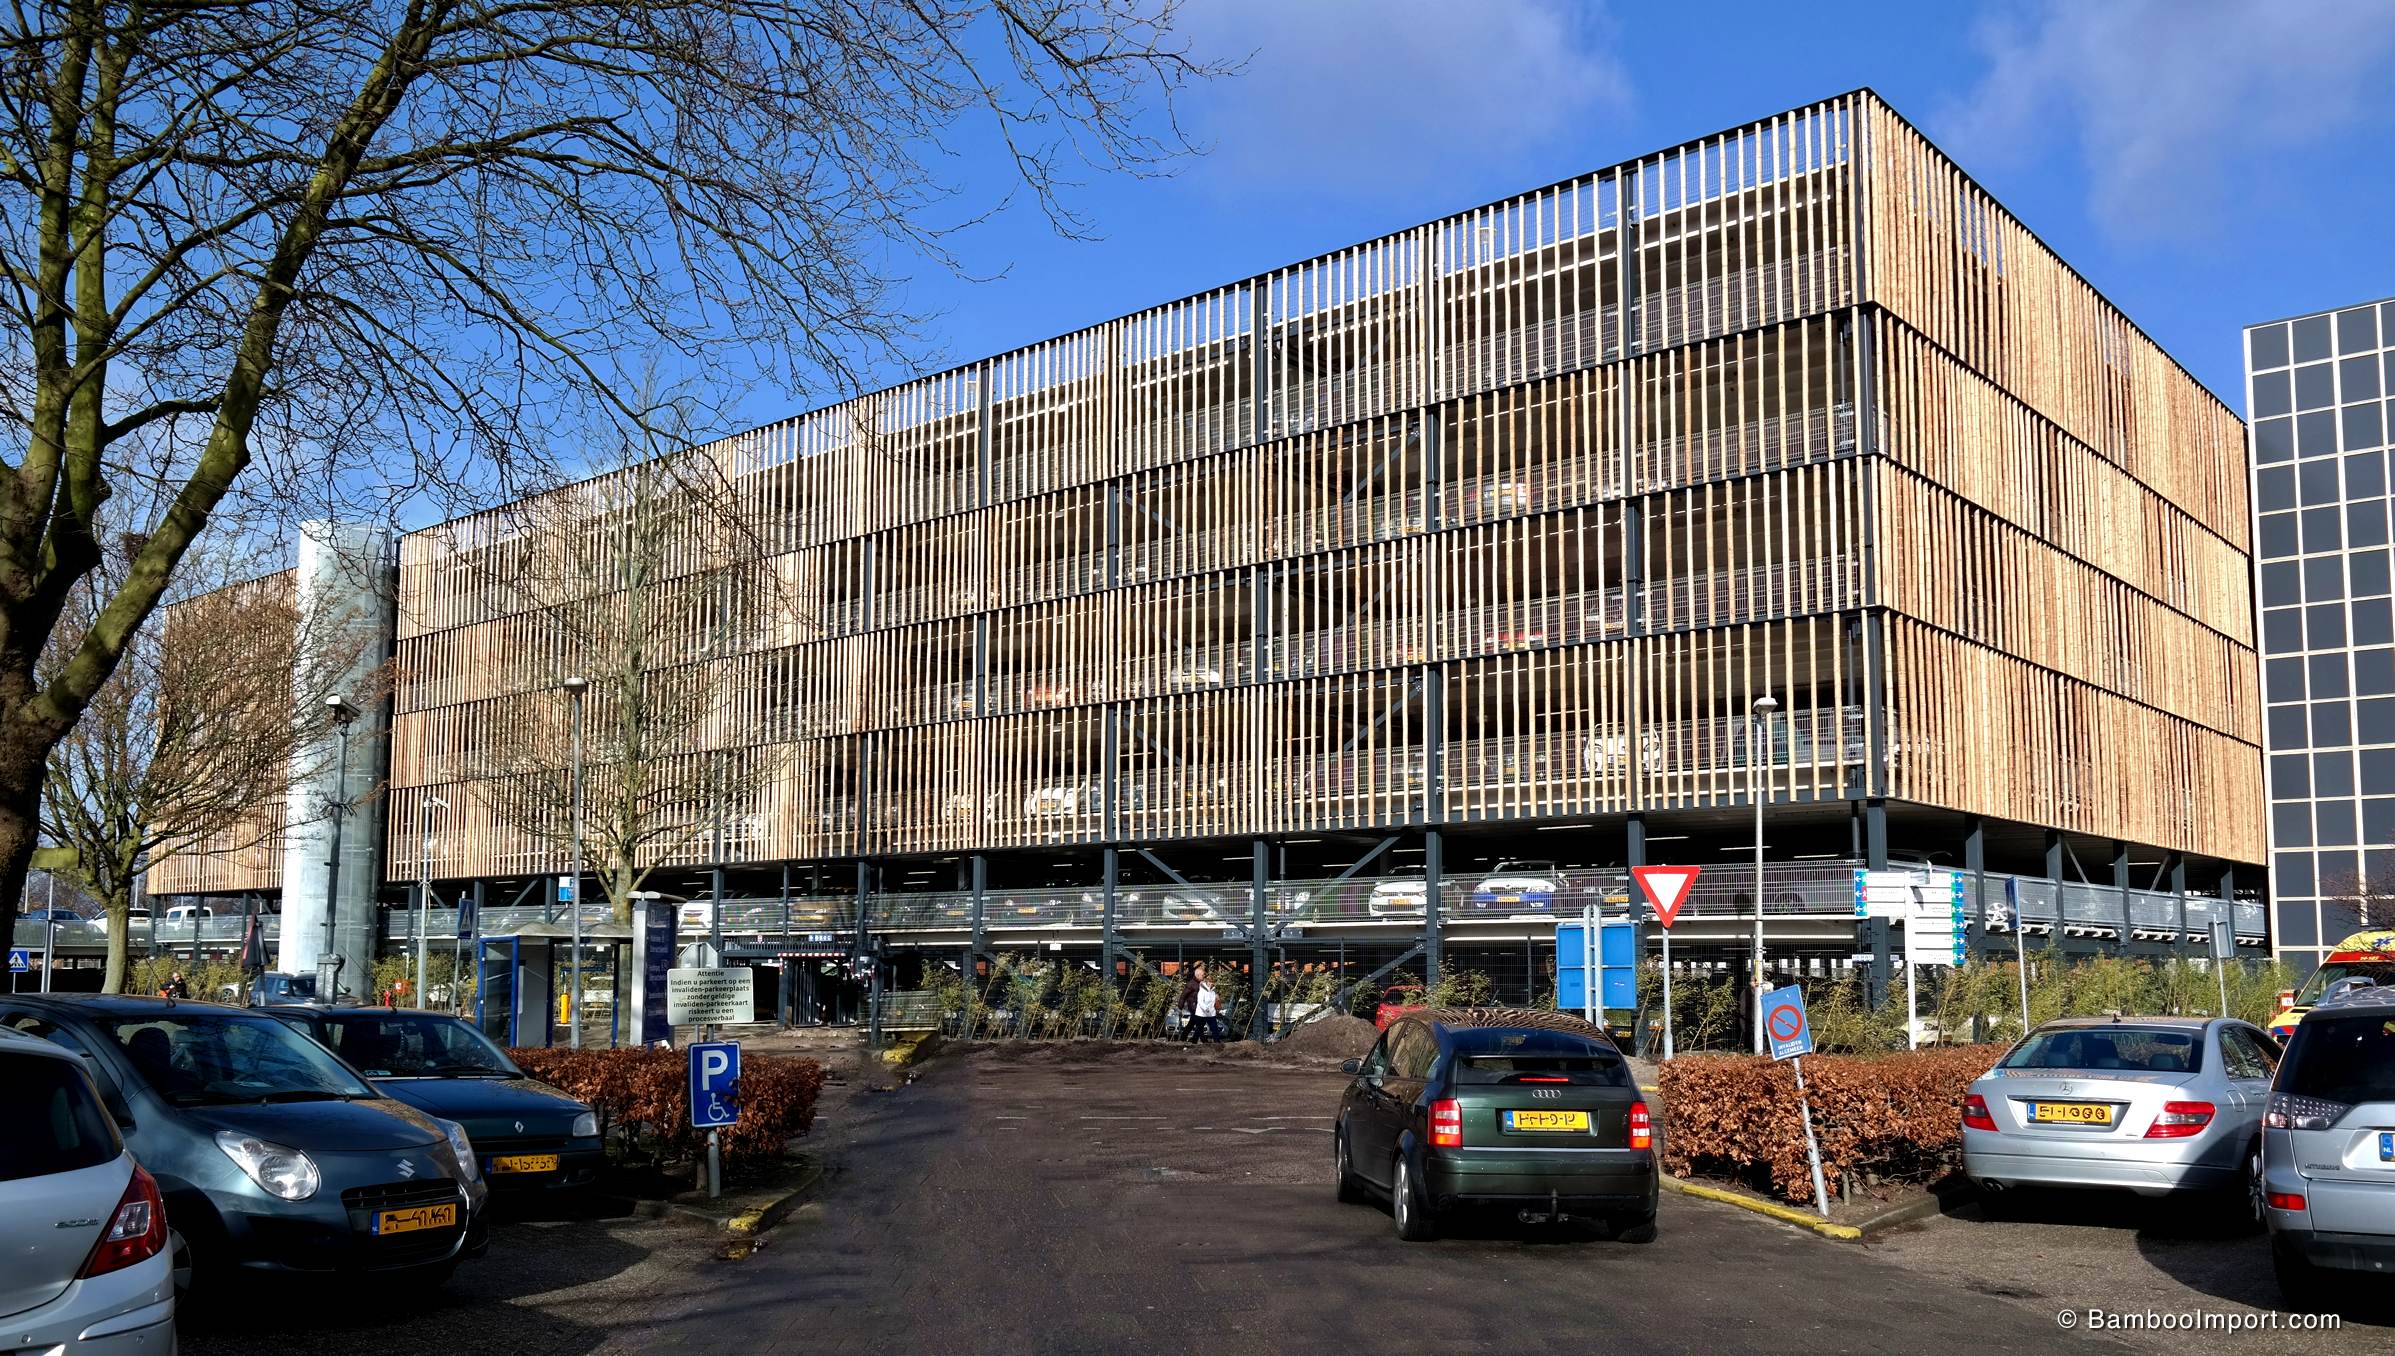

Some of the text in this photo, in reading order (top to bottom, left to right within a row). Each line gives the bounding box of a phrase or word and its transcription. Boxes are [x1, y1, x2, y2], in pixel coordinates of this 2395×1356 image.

[699, 979, 728, 987] parkeert
[671, 985, 750, 993] invaliden-parkeerplaats
[710, 992, 736, 1001] geldige
[673, 1000, 749, 1008] invaliden-parkeerkaart
[688, 1014, 735, 1023] procesverbaal
[702, 1050, 728, 1091] P
